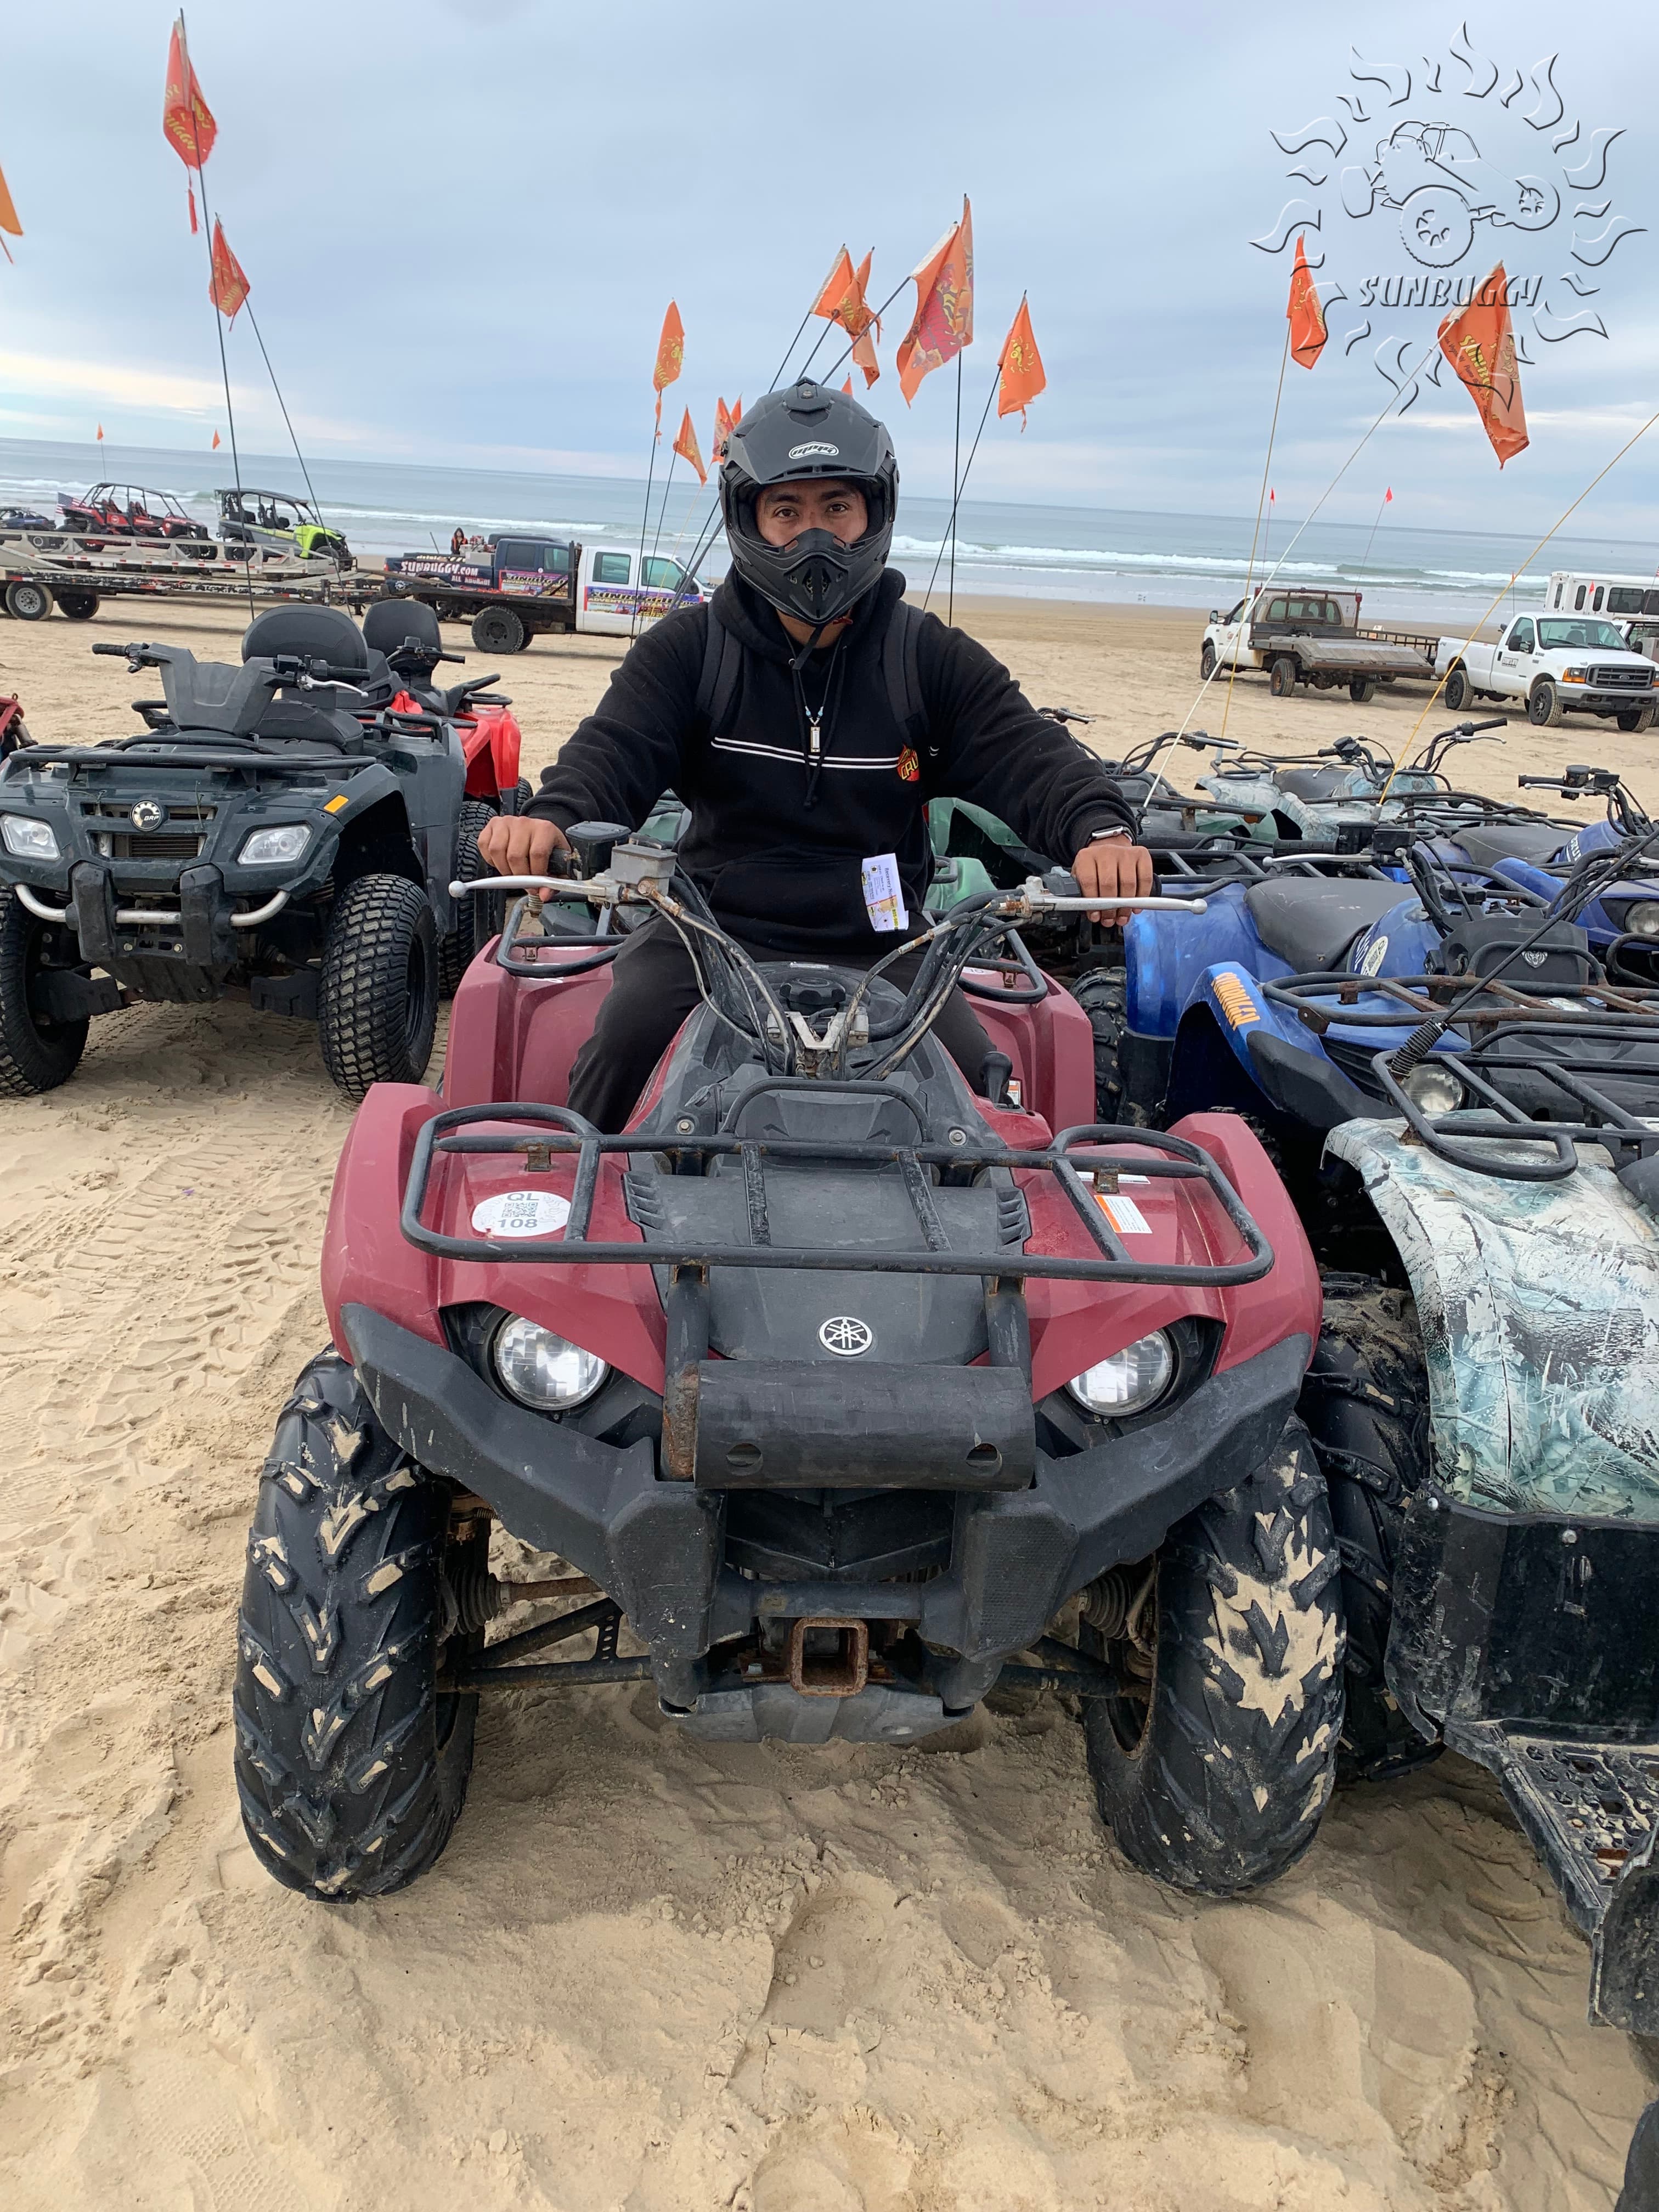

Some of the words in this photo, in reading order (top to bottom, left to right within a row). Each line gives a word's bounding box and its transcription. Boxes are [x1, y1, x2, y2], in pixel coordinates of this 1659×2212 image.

[401, 561, 479, 576] SUNBUGGY.COM
[901, 758, 918, 780] CRU
[507, 1193, 540, 1201] QL
[498, 1219, 538, 1228] 108
